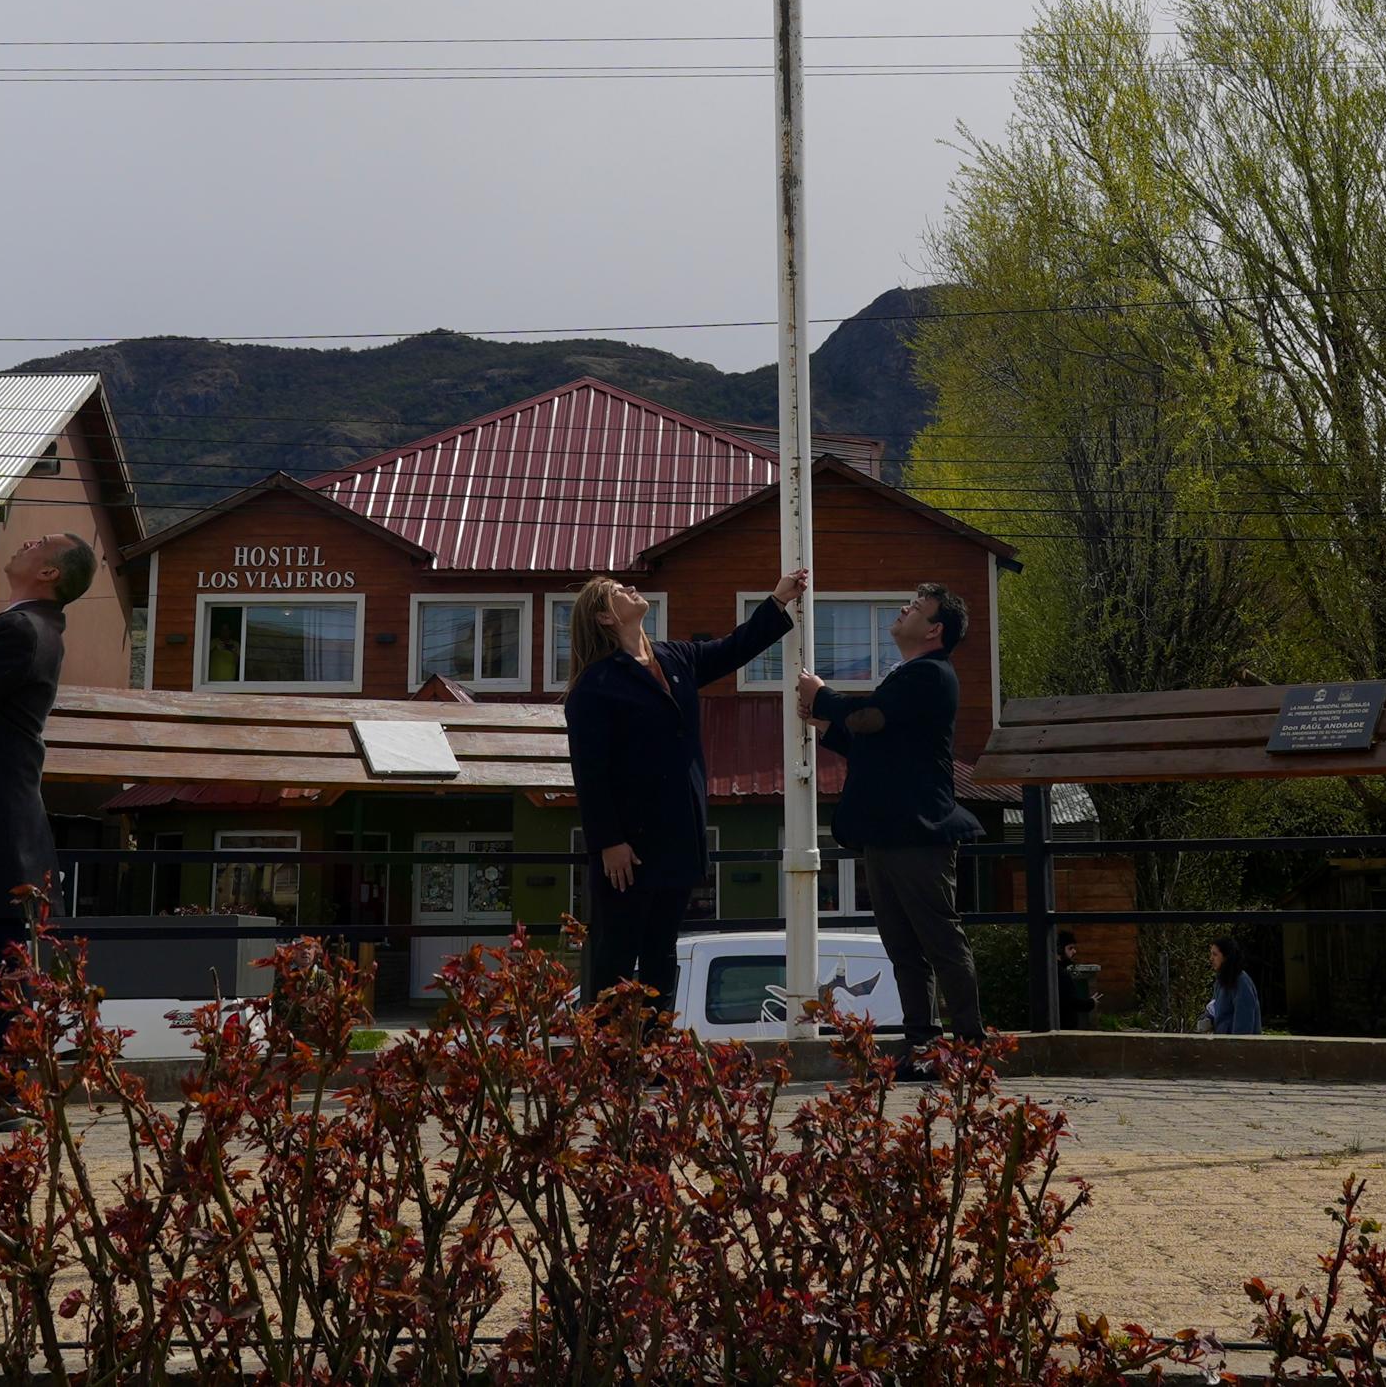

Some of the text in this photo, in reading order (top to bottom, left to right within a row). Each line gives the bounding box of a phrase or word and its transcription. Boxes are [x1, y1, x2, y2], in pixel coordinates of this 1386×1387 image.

[233, 545, 326, 567] HOSTEL
[196, 571, 357, 589] LOS VIAJEROS
[1300, 722, 1322, 731] RAÚL
[1324, 721, 1365, 729] ANDRADE
